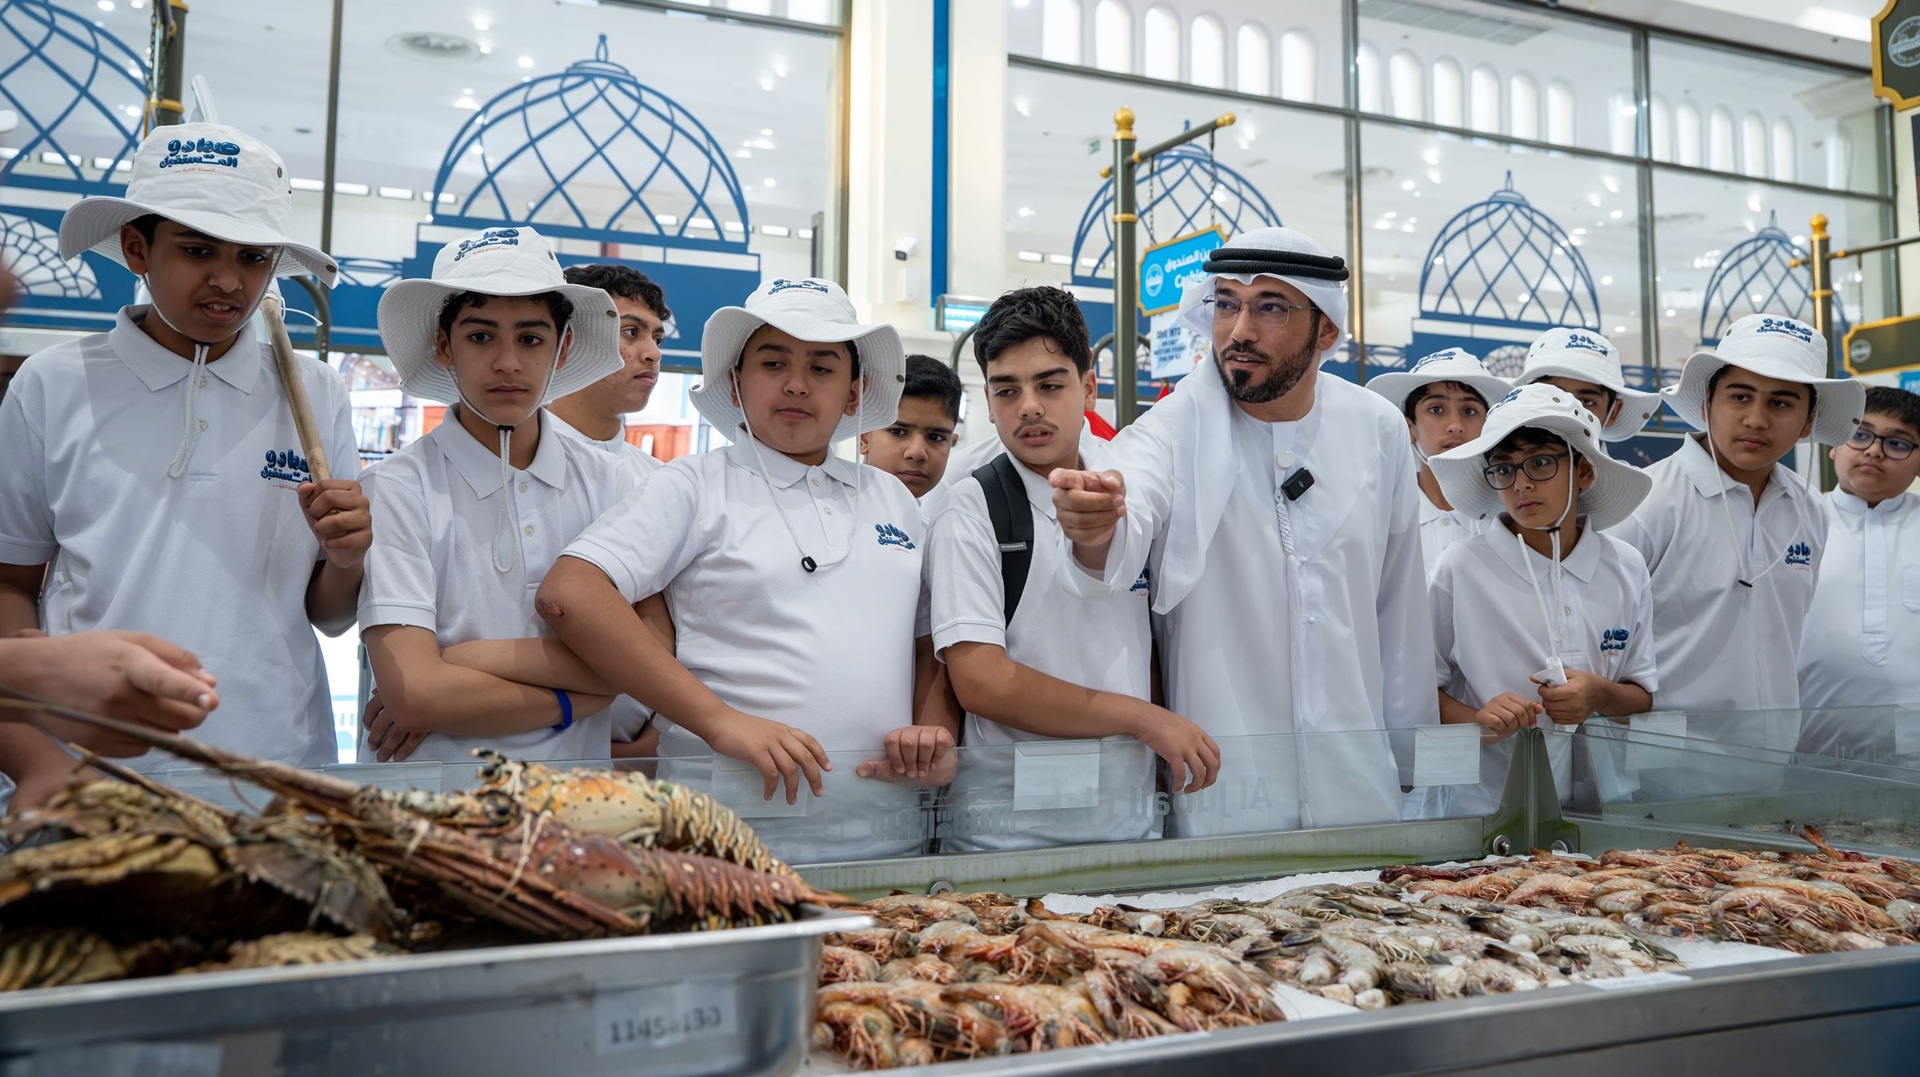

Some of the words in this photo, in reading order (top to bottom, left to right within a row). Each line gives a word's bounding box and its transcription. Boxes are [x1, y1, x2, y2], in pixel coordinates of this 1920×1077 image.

[168, 137, 240, 157] صيادو
[159, 154, 238, 169] المستقبل
[1762, 318, 1813, 336] صيادو
